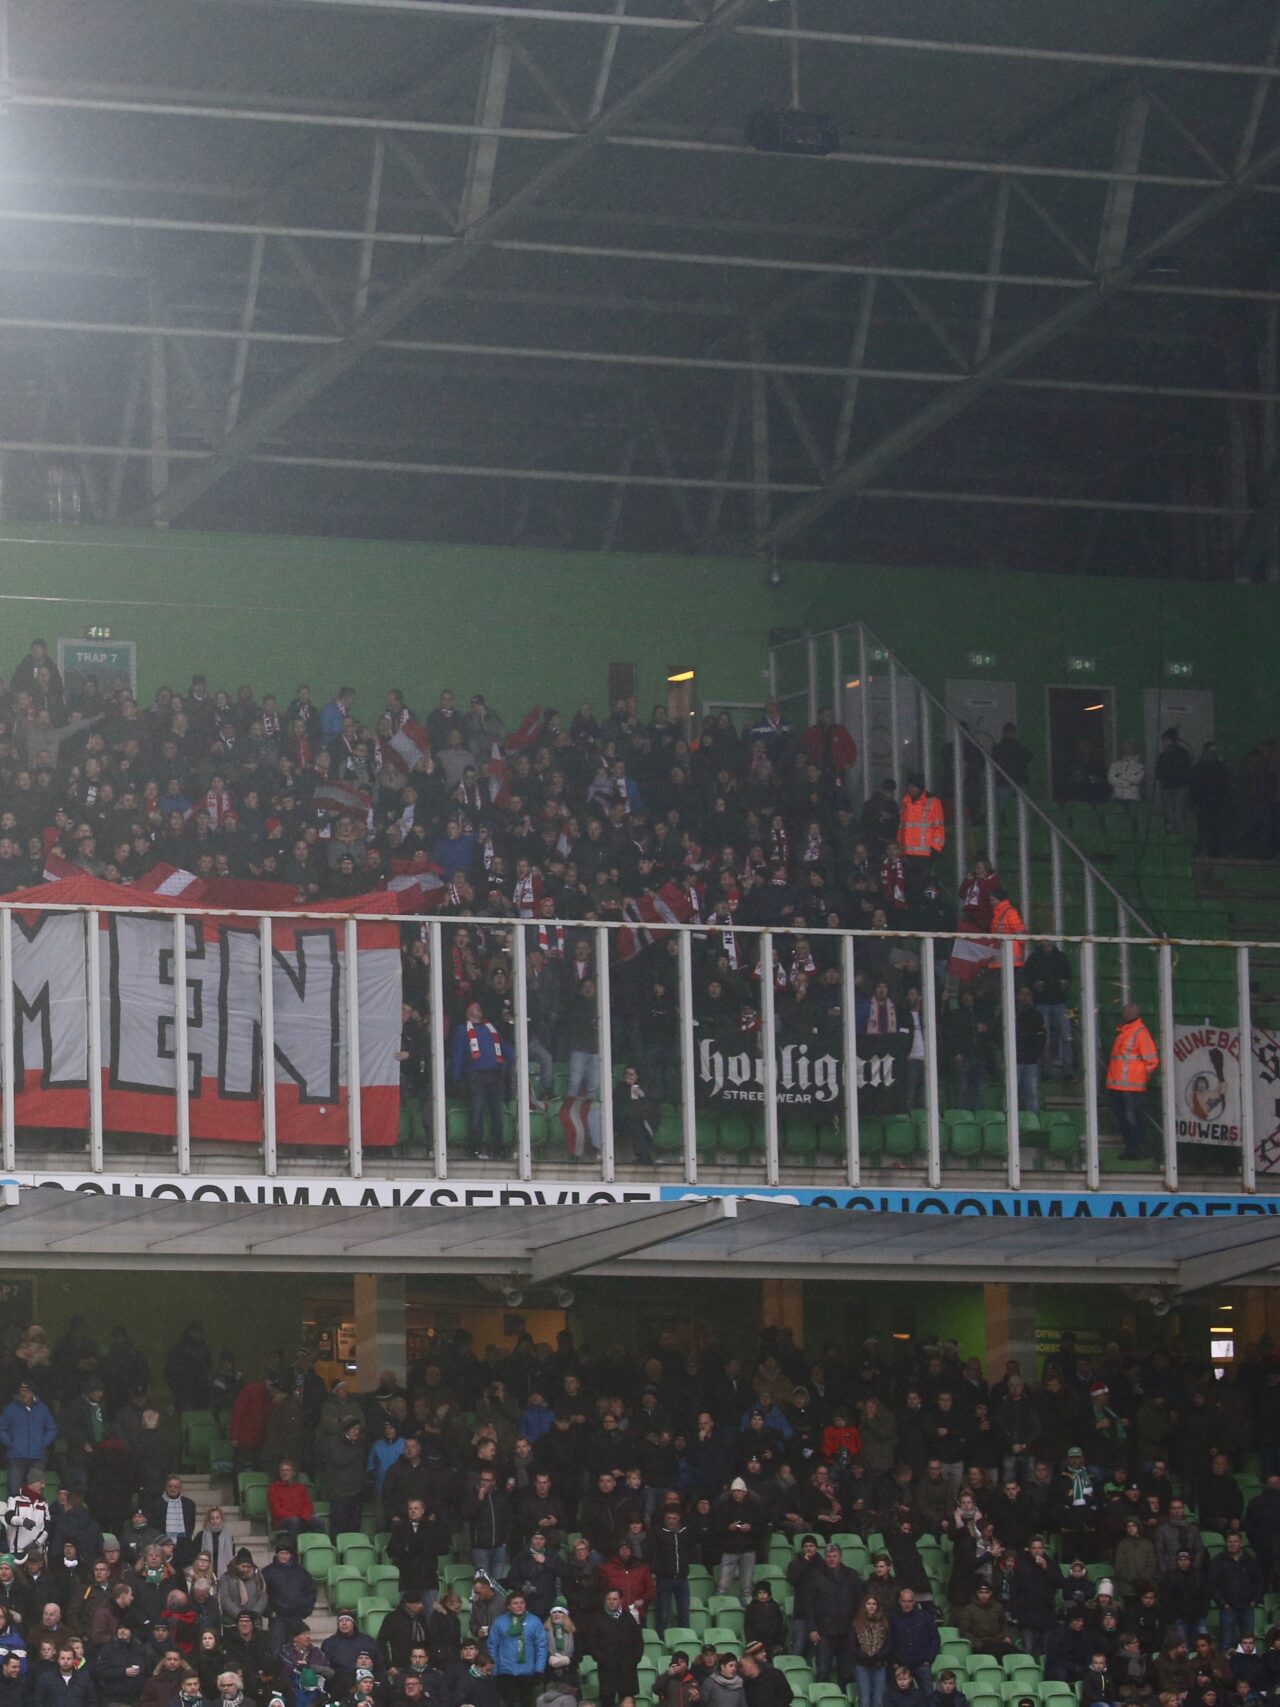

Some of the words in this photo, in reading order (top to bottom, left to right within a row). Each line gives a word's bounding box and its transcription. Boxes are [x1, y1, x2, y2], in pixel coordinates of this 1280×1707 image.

[75, 652, 108, 663] TRAP
[722, 1090, 812, 1104] STREEWEAR
[1175, 1120, 1239, 1142] OUWERS
